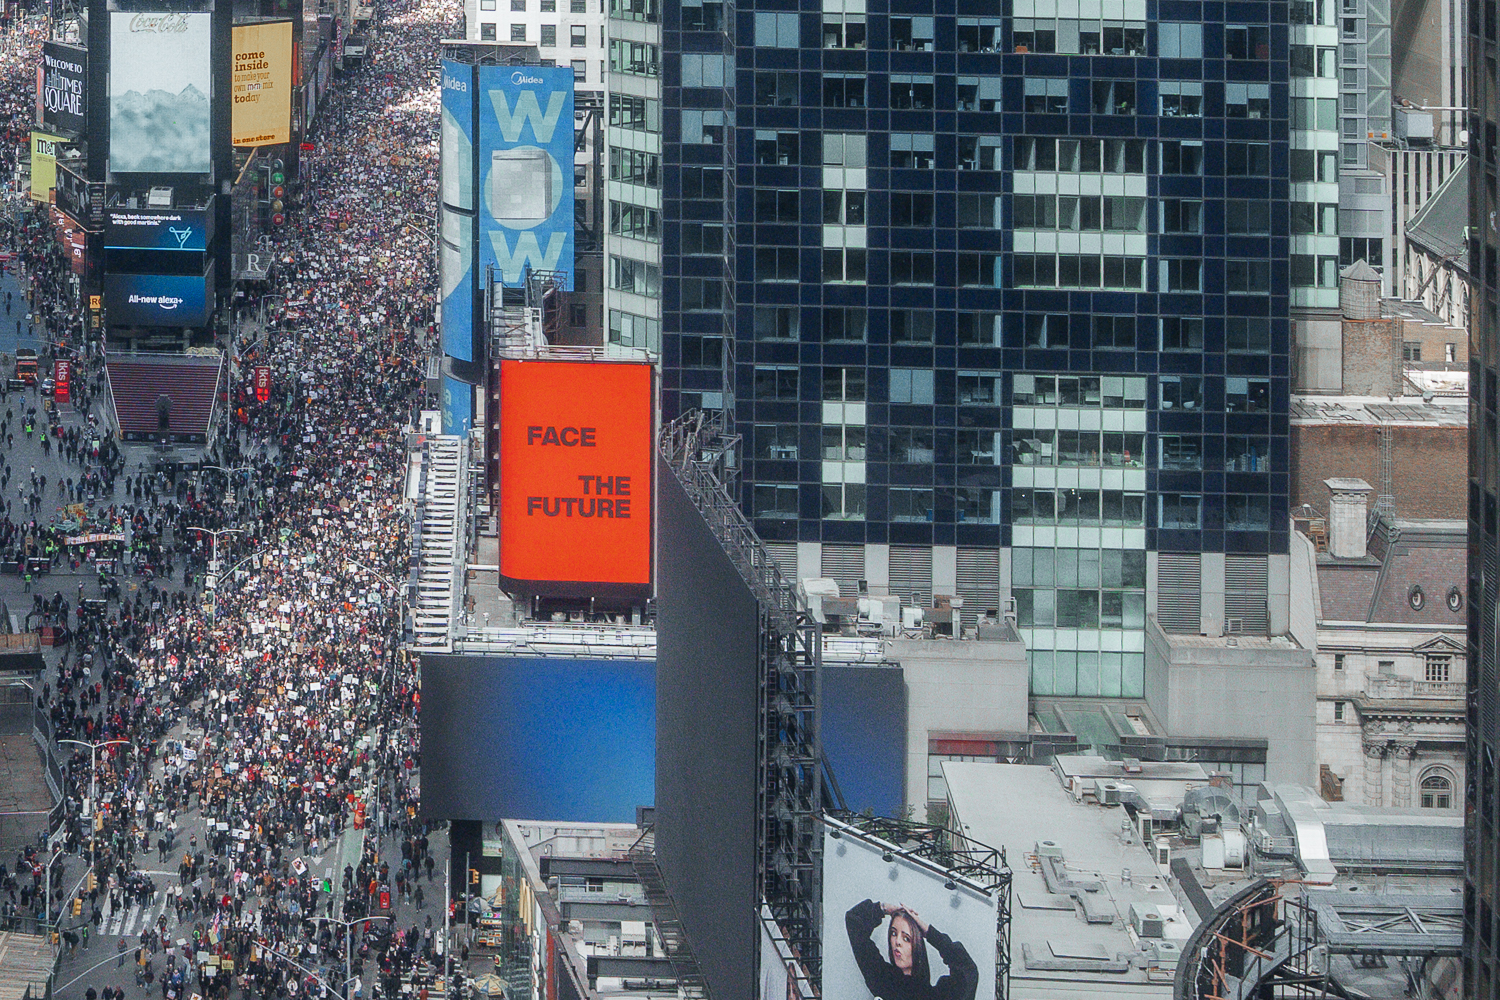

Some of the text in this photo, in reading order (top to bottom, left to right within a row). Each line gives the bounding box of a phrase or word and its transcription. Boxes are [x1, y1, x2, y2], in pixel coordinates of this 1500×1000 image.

[45, 55, 83, 74] WELCOME TO
[235, 51, 265, 61] come
[234, 60, 269, 72] inside
[60, 76, 82, 95] TIMES
[234, 74, 241, 82] to
[442, 73, 467, 93] Midea
[513, 72, 544, 85] Midea
[234, 84, 246, 92] own
[45, 87, 84, 117] SQUARE
[234, 93, 261, 104] today
[488, 90, 567, 143] W
[255, 134, 275, 142] store
[247, 253, 262, 272] R
[128, 294, 157, 304] All-new
[58, 362, 69, 381] tkts
[258, 369, 269, 388] tkts
[527, 426, 596, 447] FACE
[578, 475, 631, 496] THE
[527, 496, 631, 519] FUTURE
